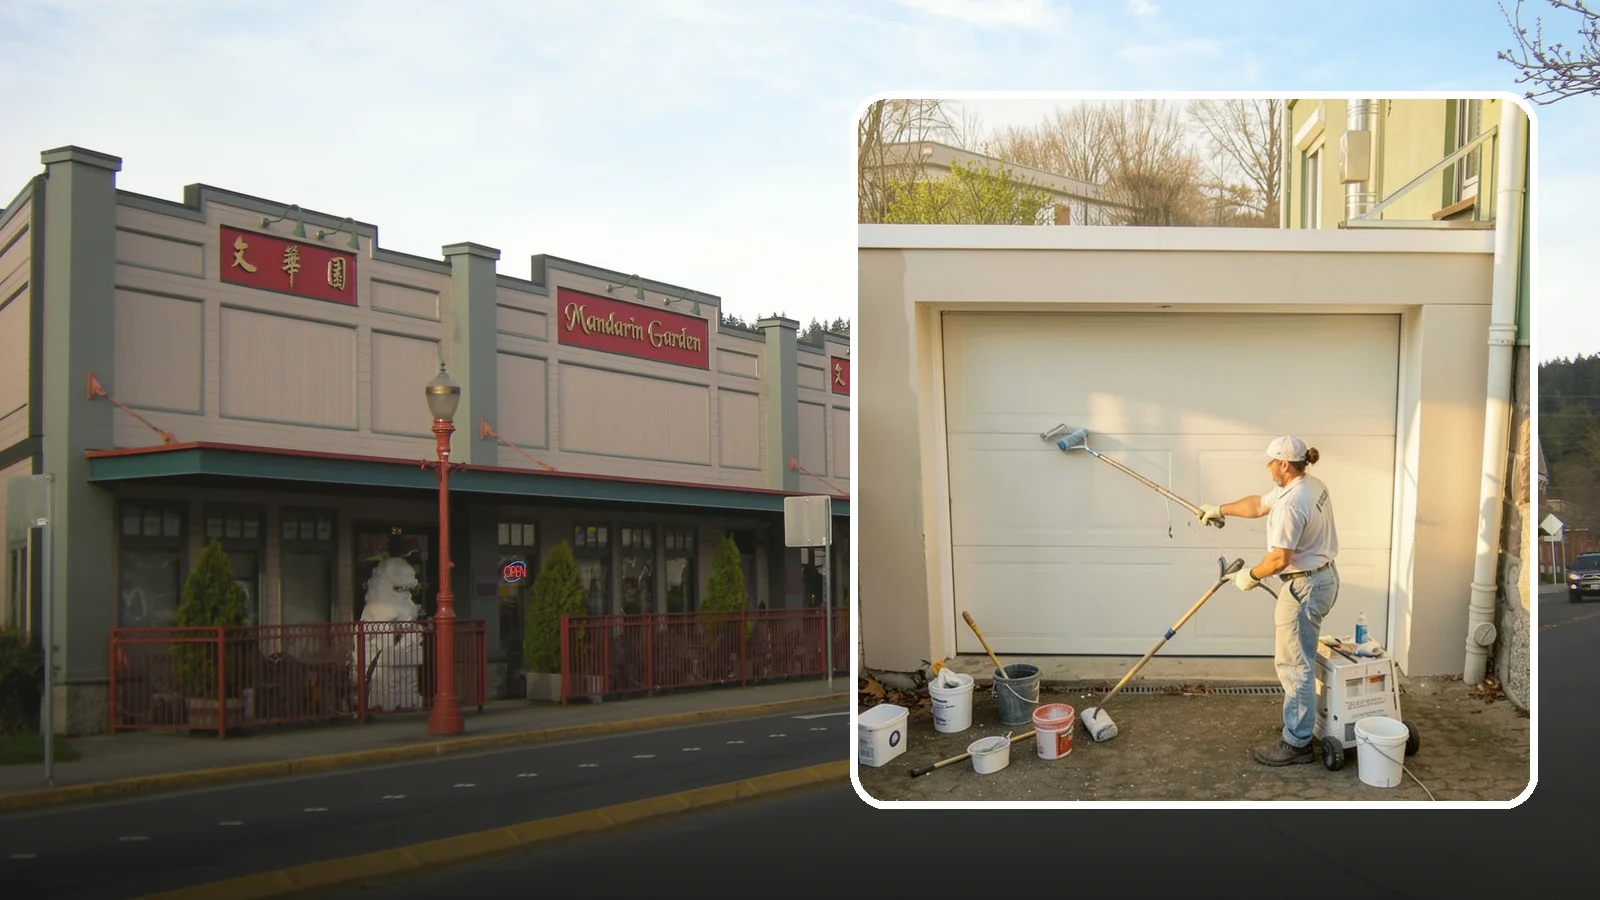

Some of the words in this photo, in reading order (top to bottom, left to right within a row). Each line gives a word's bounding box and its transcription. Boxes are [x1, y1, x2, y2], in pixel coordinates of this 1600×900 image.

[231, 236, 346, 291] 文華園
[564, 302, 644, 341] Mandarin
[648, 320, 702, 352] Garden
[503, 565, 527, 578] OPEN
